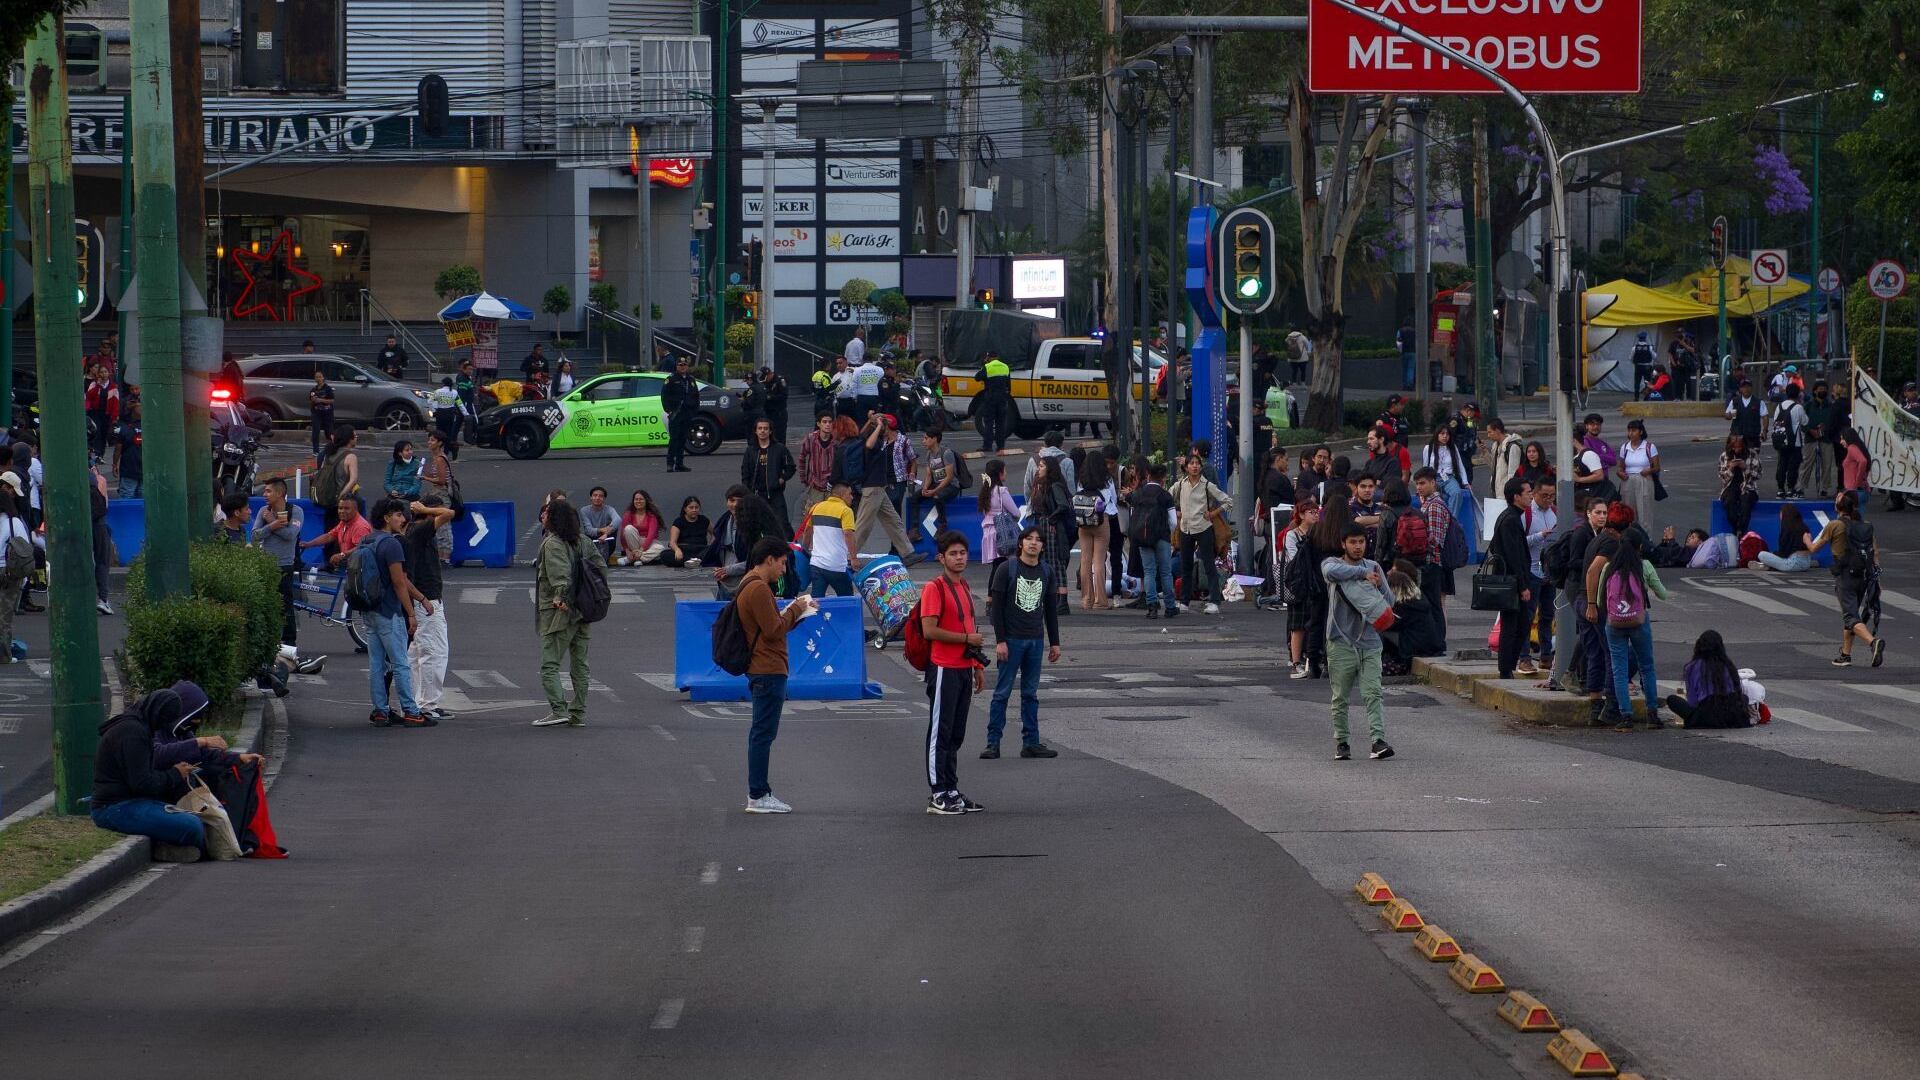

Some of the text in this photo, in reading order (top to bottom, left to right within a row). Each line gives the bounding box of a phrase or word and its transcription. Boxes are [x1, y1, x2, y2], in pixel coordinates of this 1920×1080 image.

[1348, 34, 1601, 70] METROBUS
[203, 117, 375, 153] URANO
[844, 168, 898, 179] VenturesSoft
[748, 202, 810, 212] WKER
[843, 234, 876, 247] Carl's
[1039, 383, 1099, 397] TRANSITO
[1042, 403, 1064, 412] SSC
[598, 413, 659, 427] TRÁNSITO
[648, 432, 669, 441] SSC
